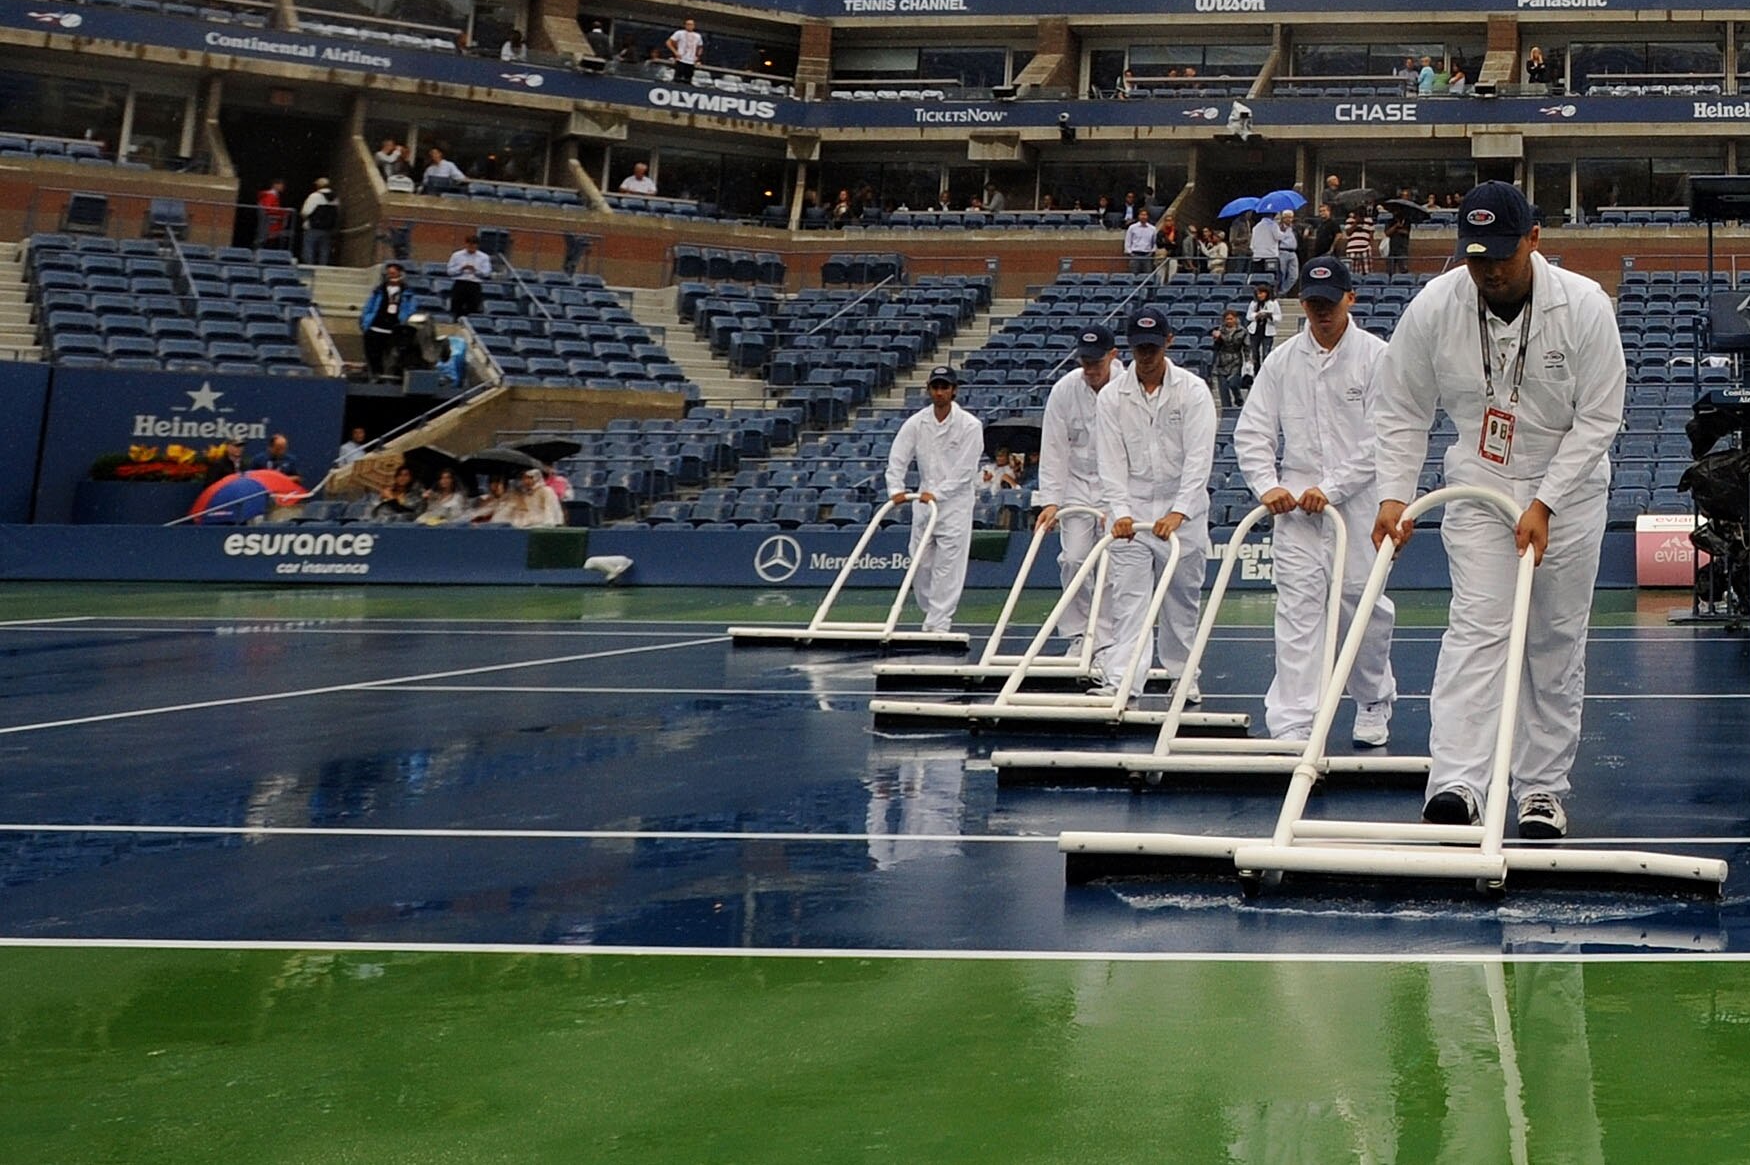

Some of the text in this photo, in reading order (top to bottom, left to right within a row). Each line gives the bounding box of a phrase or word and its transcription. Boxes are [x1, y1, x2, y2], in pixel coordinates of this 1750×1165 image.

[205, 31, 392, 69] Continental Airlines
[648, 87, 776, 119] OLYMPUS
[1335, 103, 1418, 122] CHASE
[133, 415, 267, 440] Heineken
[223, 533, 375, 556] esurance
[275, 560, 370, 575] car insurance
[809, 553, 912, 570] Meredes-Be
